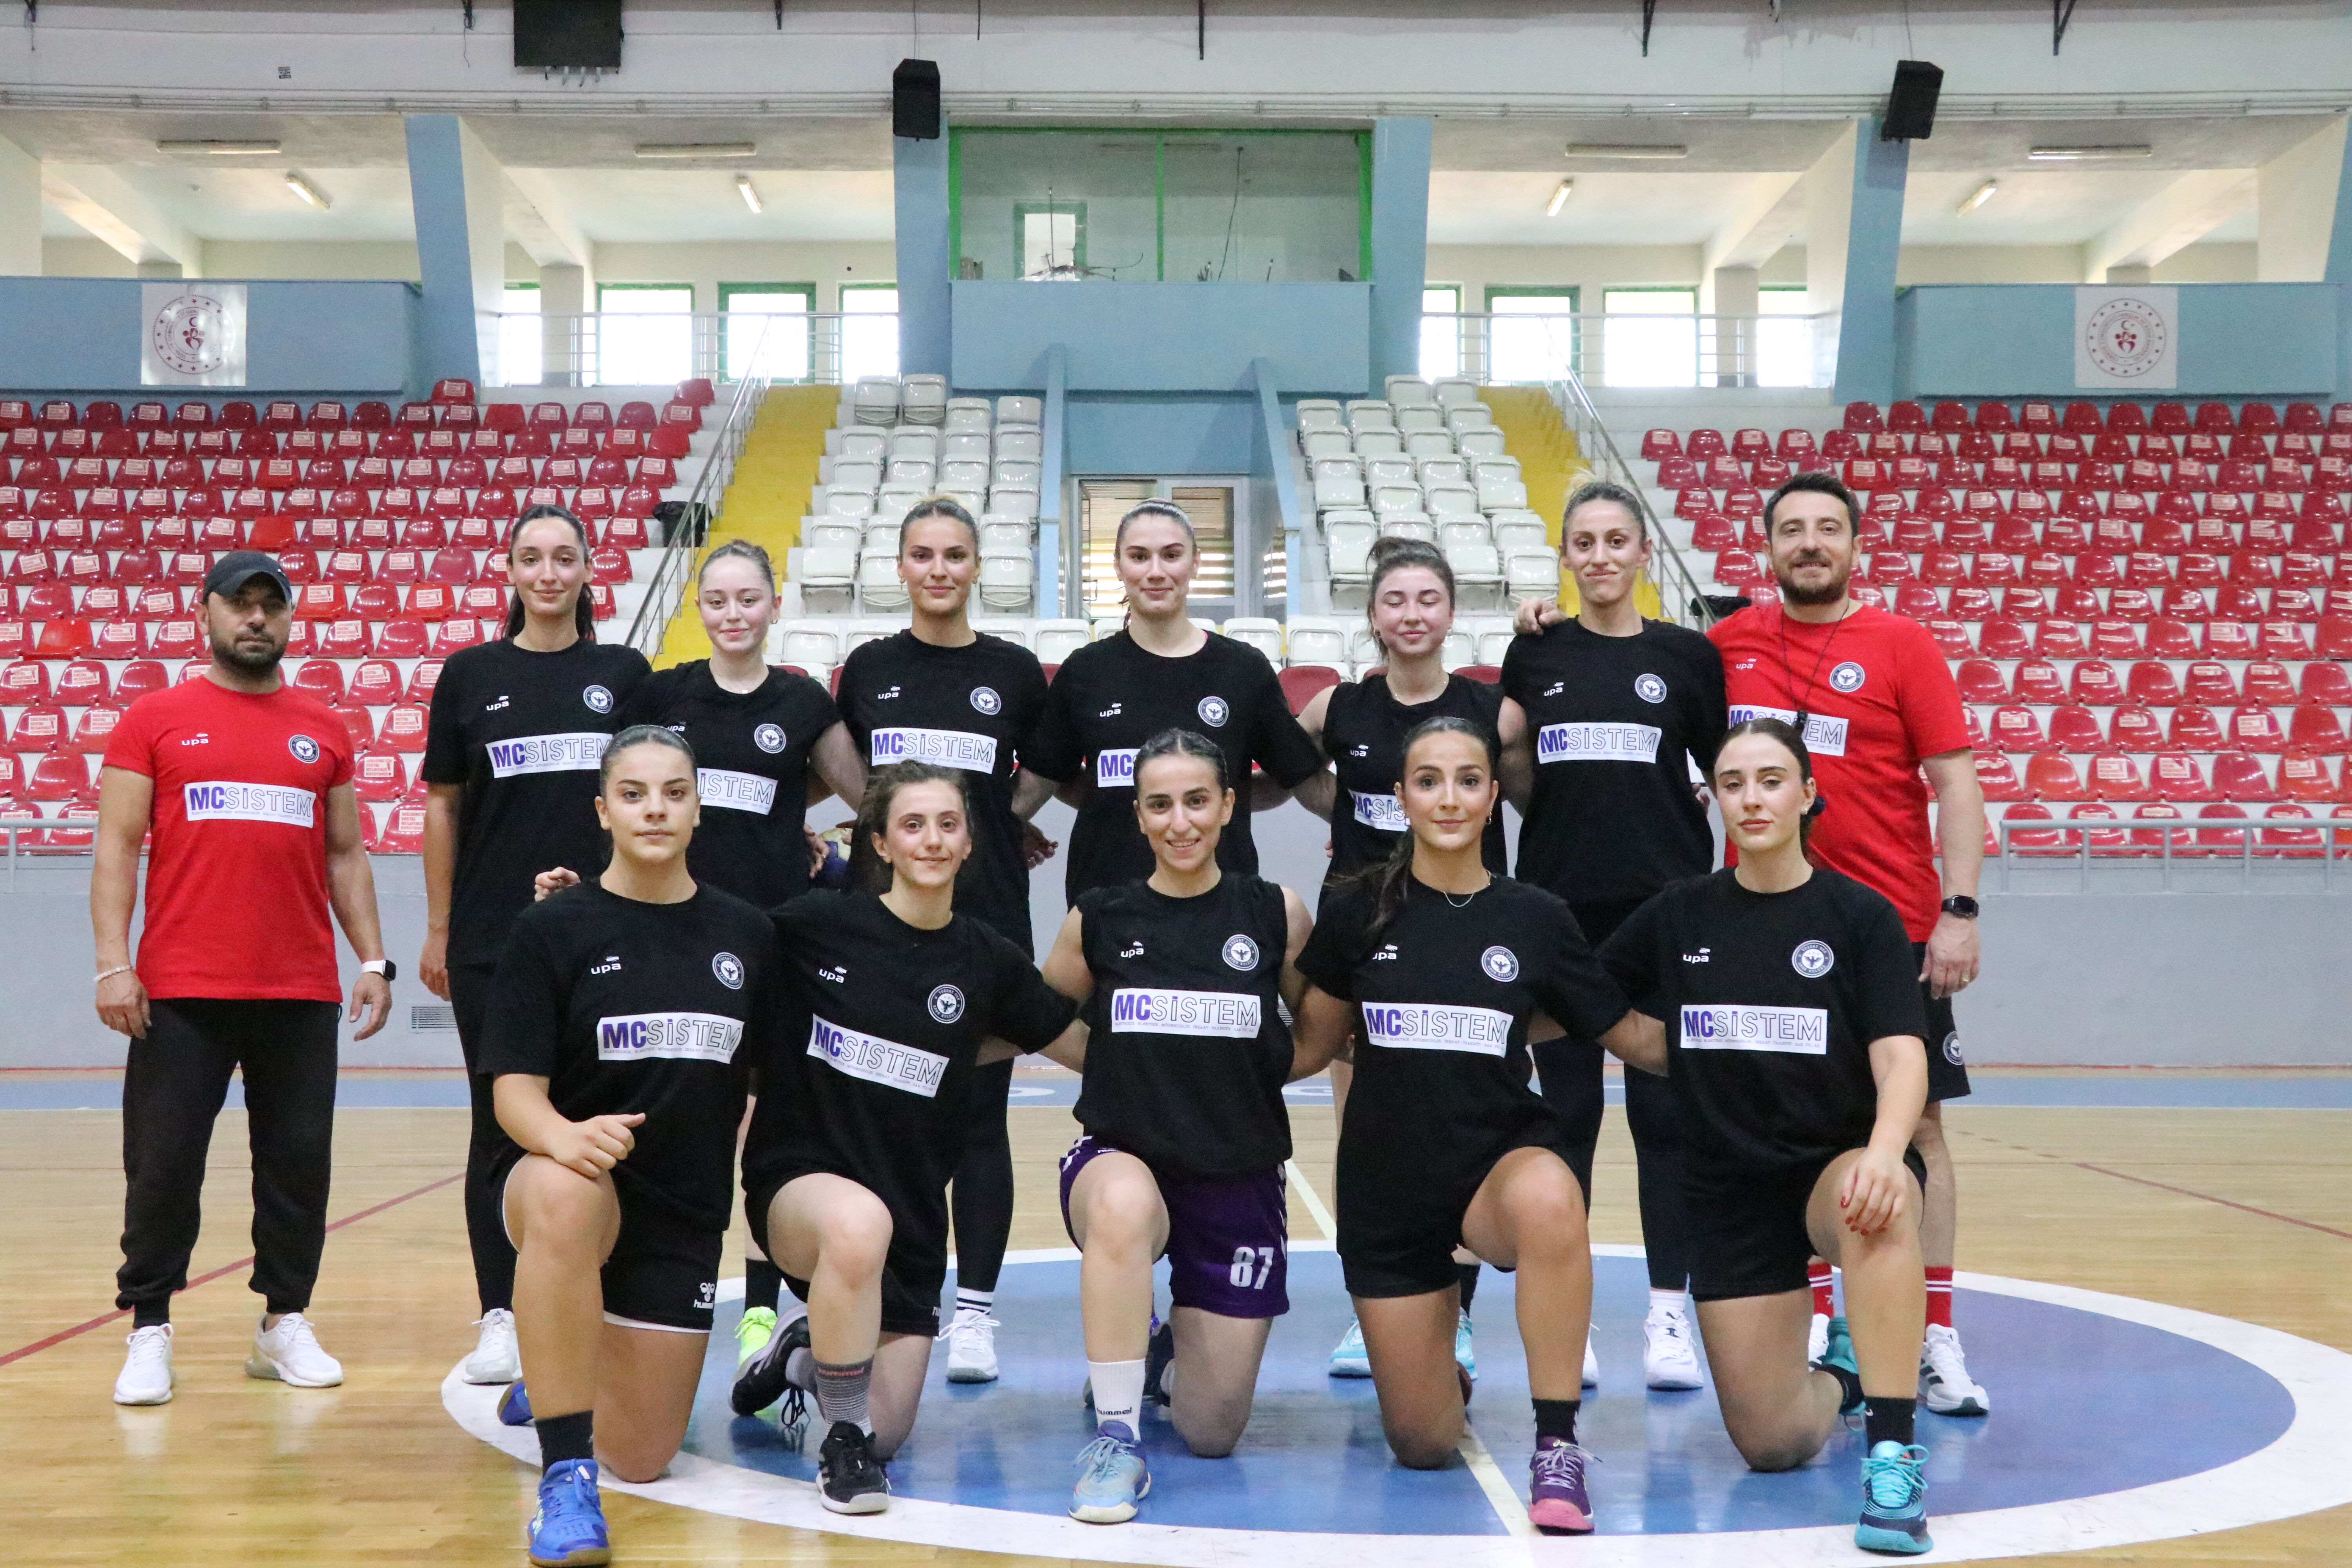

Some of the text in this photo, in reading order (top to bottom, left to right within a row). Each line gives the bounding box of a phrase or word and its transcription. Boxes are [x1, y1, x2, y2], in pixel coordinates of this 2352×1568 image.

[878, 691, 899, 700] upa
[1544, 687, 1563, 697] upa
[486, 701, 509, 711] upa
[1100, 709, 1121, 717] upa
[1121, 947, 1144, 958] upa
[1683, 954, 1709, 964] upa
[591, 963, 621, 975] upa
[818, 968, 845, 983] upa
[1230, 1246, 1274, 1290] 87
[1096, 1406, 1132, 1416] hummel
